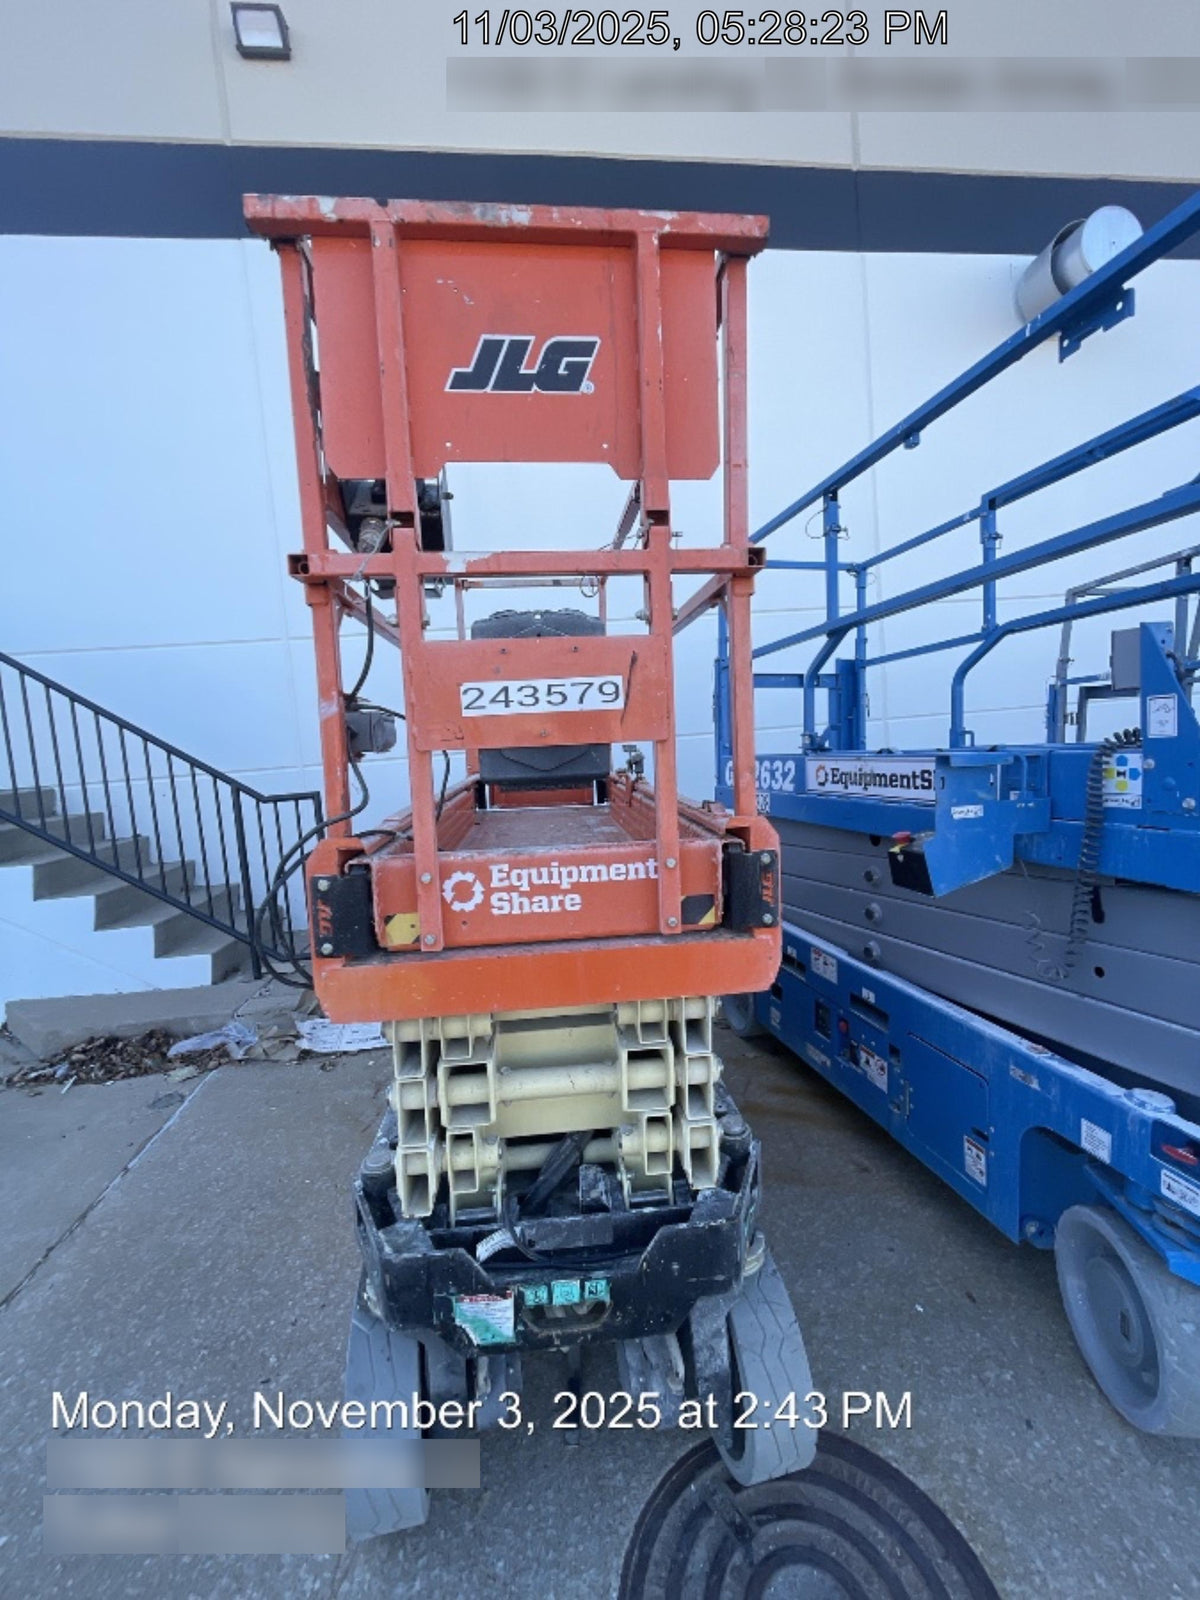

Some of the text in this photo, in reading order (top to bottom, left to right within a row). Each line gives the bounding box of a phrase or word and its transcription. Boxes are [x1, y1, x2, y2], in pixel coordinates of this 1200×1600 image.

[444, 334, 601, 395] JLG
[462, 681, 620, 710] 243579
[490, 858, 659, 891] Equipment
[490, 892, 582, 916] Share
